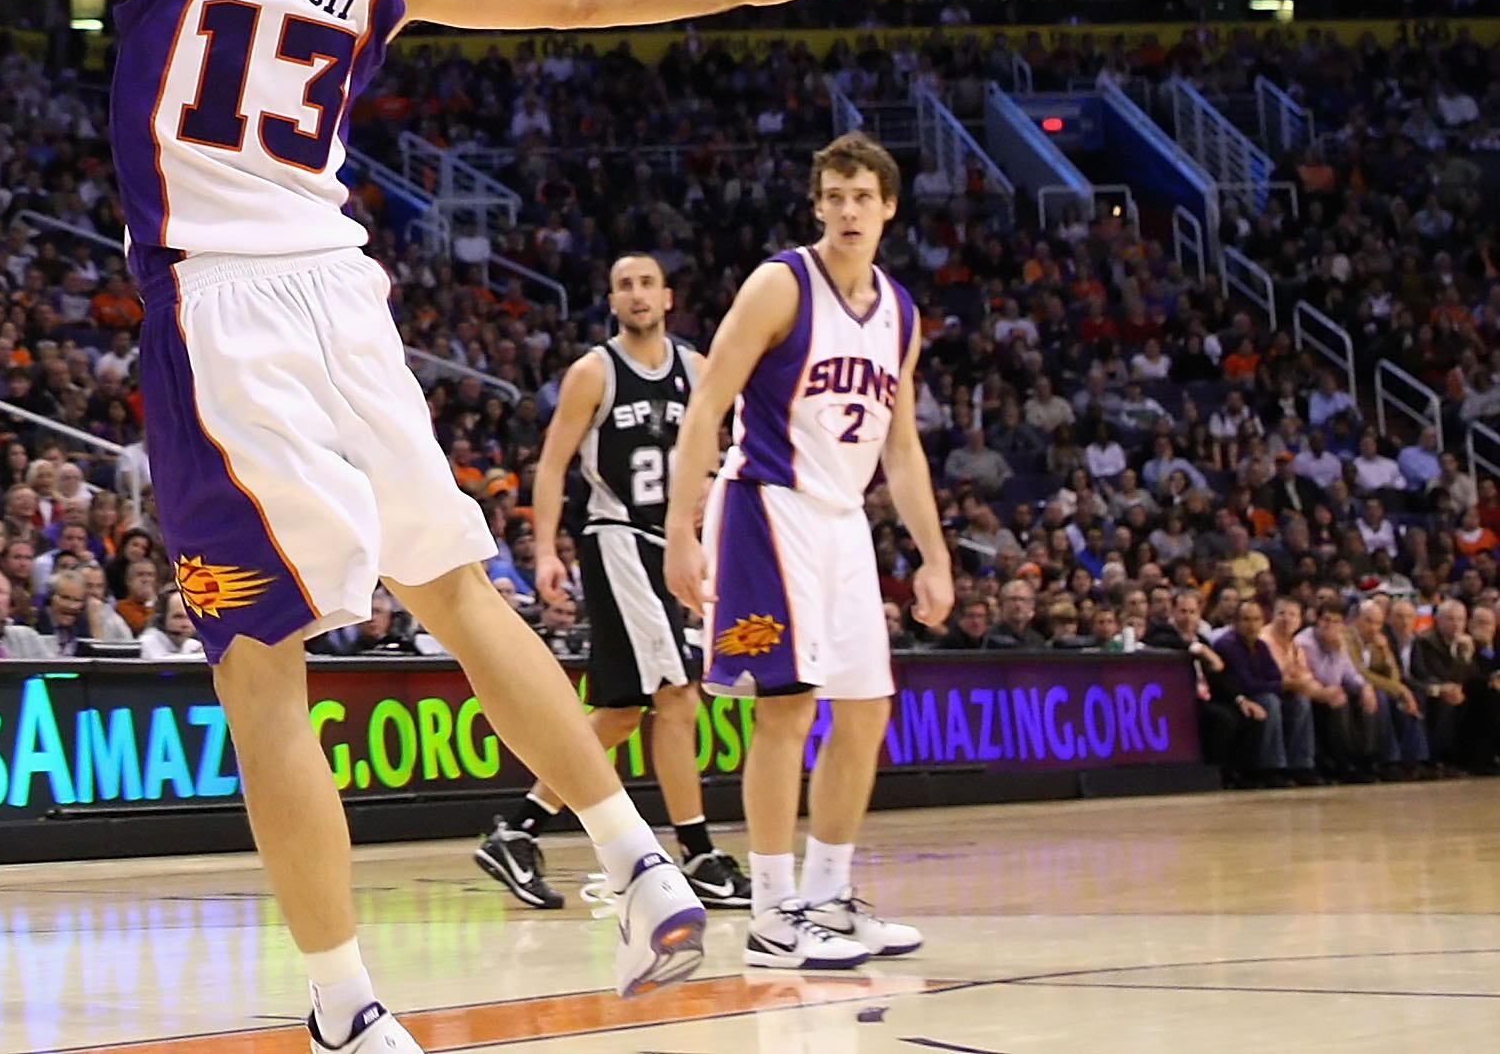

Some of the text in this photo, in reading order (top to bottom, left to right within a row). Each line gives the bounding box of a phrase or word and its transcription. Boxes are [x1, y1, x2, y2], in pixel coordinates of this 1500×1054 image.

[803, 356, 898, 409] SUNS
[612, 400, 686, 438] SPUR
[839, 403, 866, 444] 2
[630, 445, 678, 505] 2
